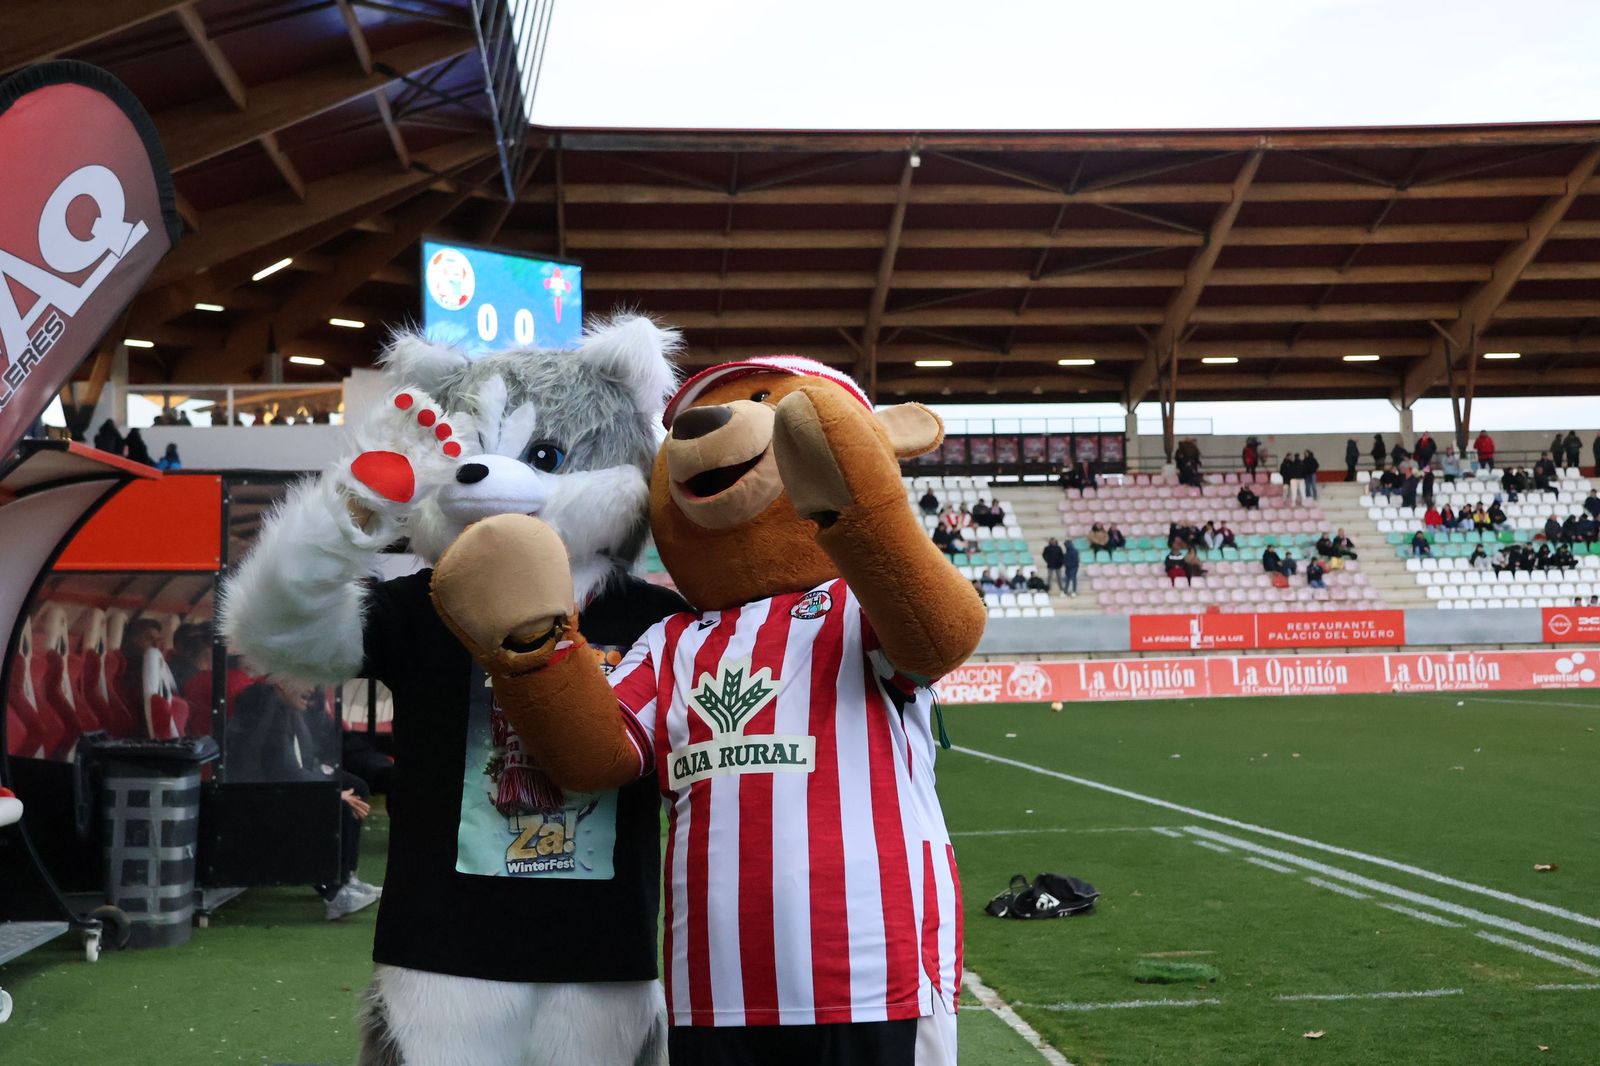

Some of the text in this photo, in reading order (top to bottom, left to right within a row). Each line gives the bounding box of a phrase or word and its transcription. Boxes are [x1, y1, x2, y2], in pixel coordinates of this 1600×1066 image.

[477, 303, 534, 345] 0 0
[1268, 629, 1395, 640] PALACIO DEL DUERO
[1287, 620, 1375, 631] RESTAURANTE
[1079, 662, 1195, 697] La Opinión
[1232, 656, 1348, 693] La Opinión
[1383, 655, 1500, 690] La Opinión
[673, 743, 807, 780] CAJA RURAL
[506, 809, 577, 861] Za!
[507, 858, 575, 873] WinterFest
